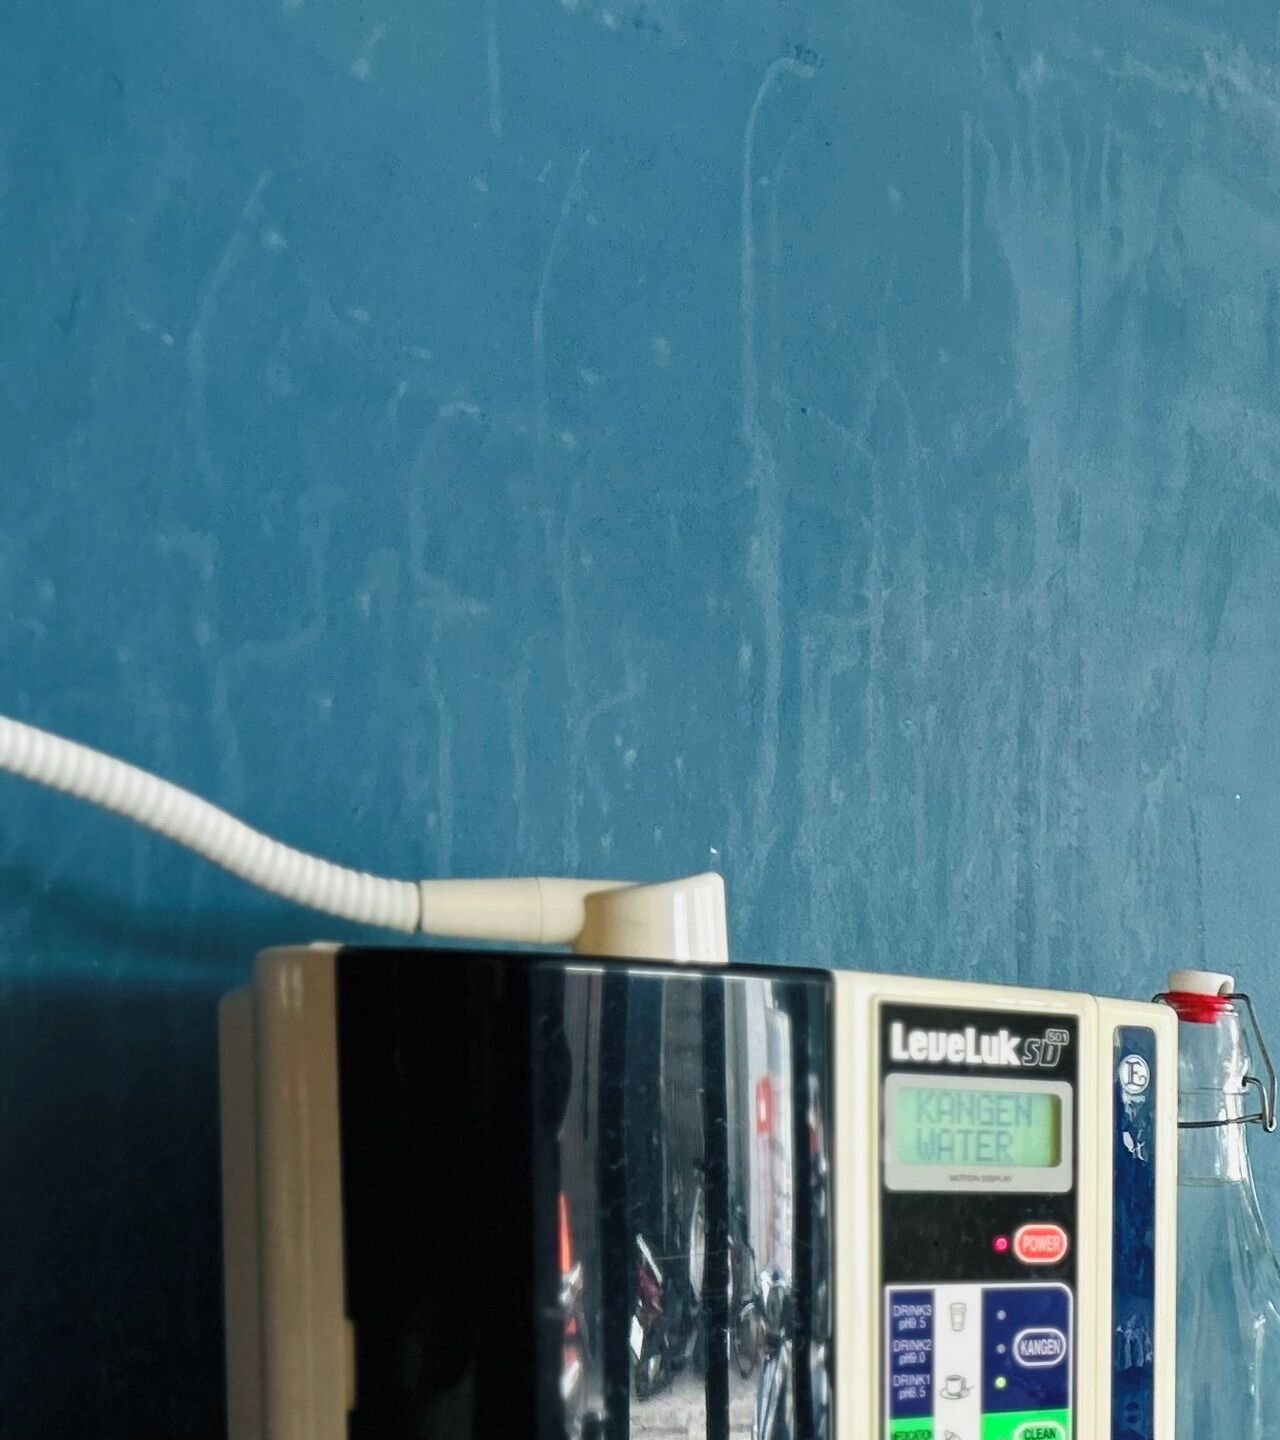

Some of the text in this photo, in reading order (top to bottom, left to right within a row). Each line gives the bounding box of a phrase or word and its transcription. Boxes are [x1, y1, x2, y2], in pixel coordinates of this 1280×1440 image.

[915, 1089, 1034, 1127] KANGEN
[915, 1128, 1014, 1164] WATER
[1022, 1236, 1062, 1253] POWER
[892, 1304, 932, 1318] DRINK3
[892, 1339, 932, 1353] DRINK2
[1020, 1339, 1062, 1357] KANGEN
[892, 1374, 931, 1387] DRINK1
[1023, 1428, 1056, 1440] CLEAN
